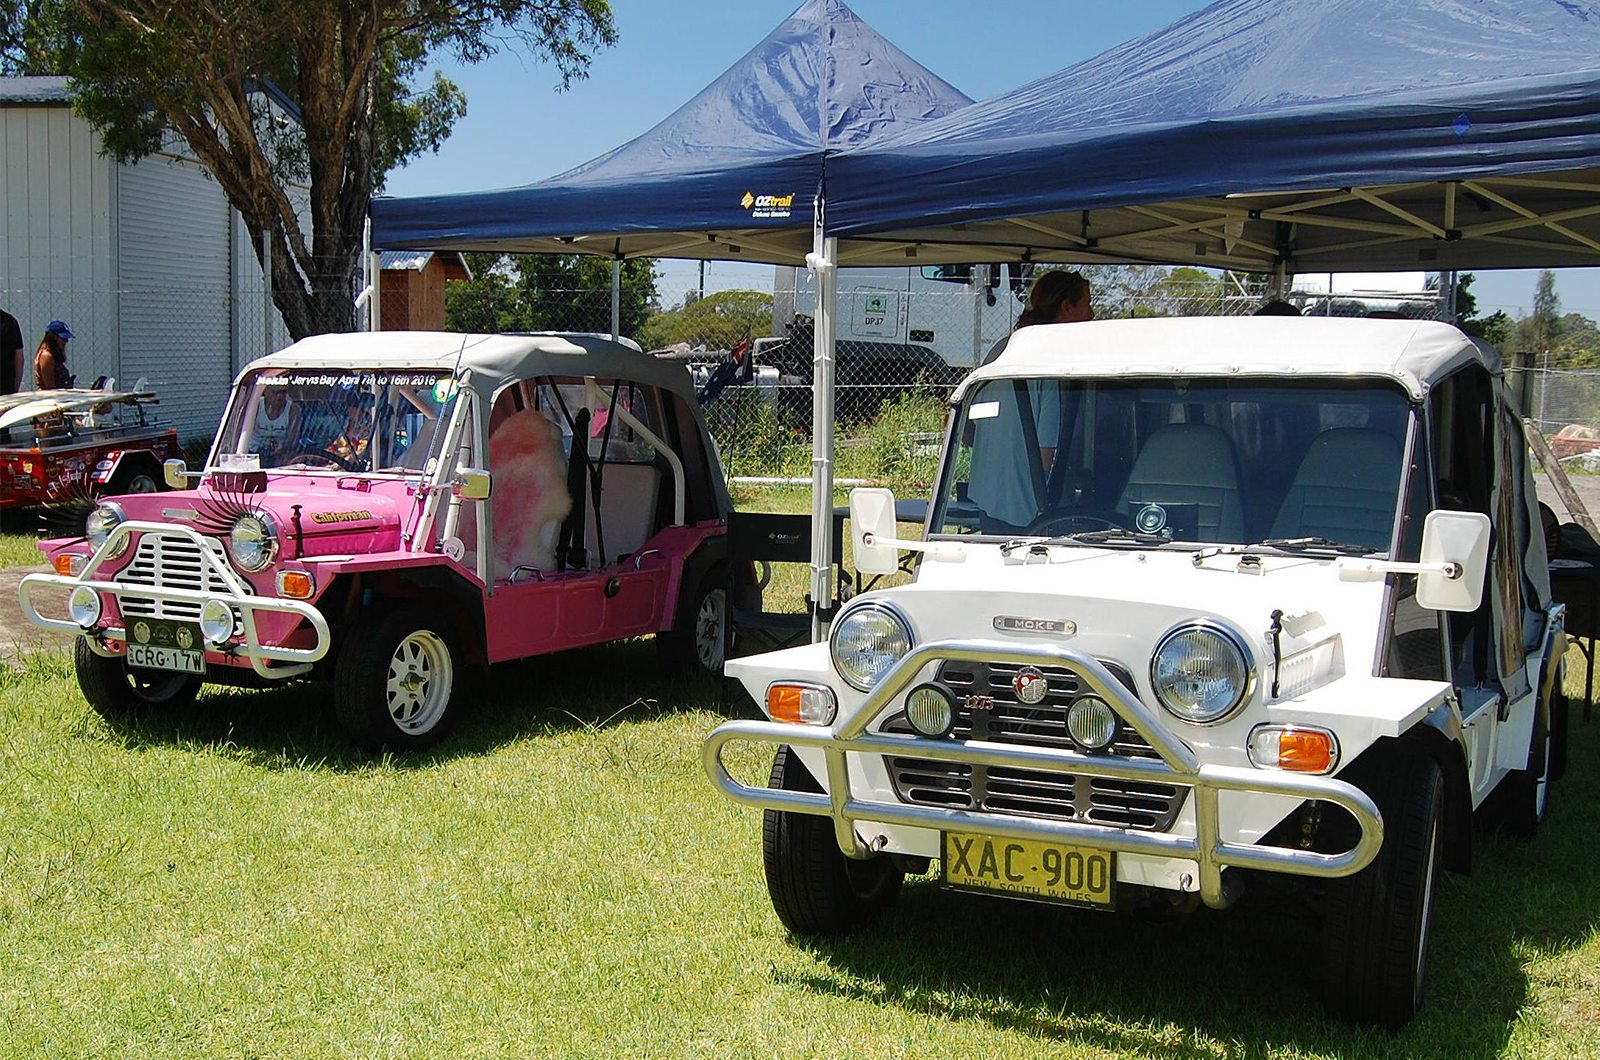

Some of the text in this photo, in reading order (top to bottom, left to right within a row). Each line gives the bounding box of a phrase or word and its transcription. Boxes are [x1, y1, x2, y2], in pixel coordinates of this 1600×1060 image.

[755, 195, 793, 207] OZtrail
[320, 374, 338, 387] Bay
[377, 375, 388, 386] to
[310, 510, 373, 525] Californian
[1014, 619, 1055, 631] MOKE
[964, 694, 995, 711] 1275
[999, 882, 1041, 895] SOUTH
